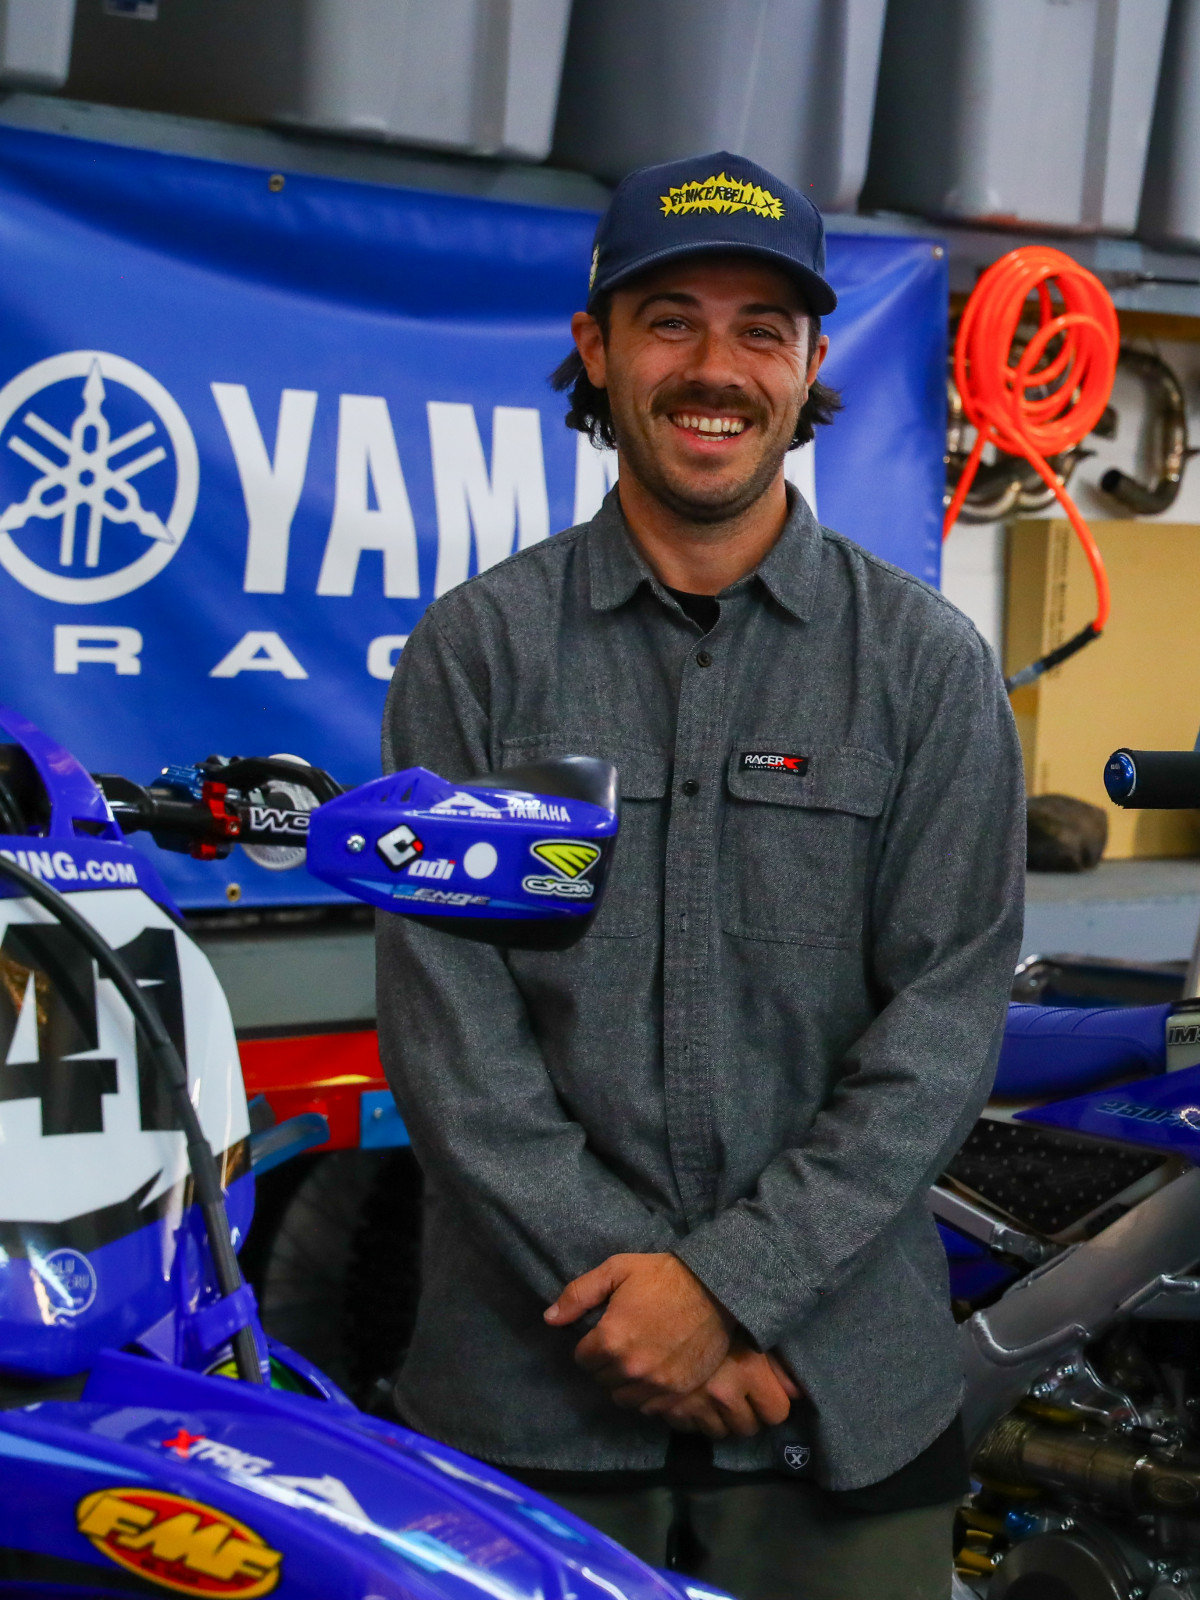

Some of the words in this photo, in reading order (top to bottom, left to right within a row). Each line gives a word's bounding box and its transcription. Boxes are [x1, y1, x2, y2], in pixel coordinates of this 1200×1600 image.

[744, 754, 785, 765] RACER
[526, 879, 592, 896] CYCRA
[78, 1493, 283, 1582] FMF
